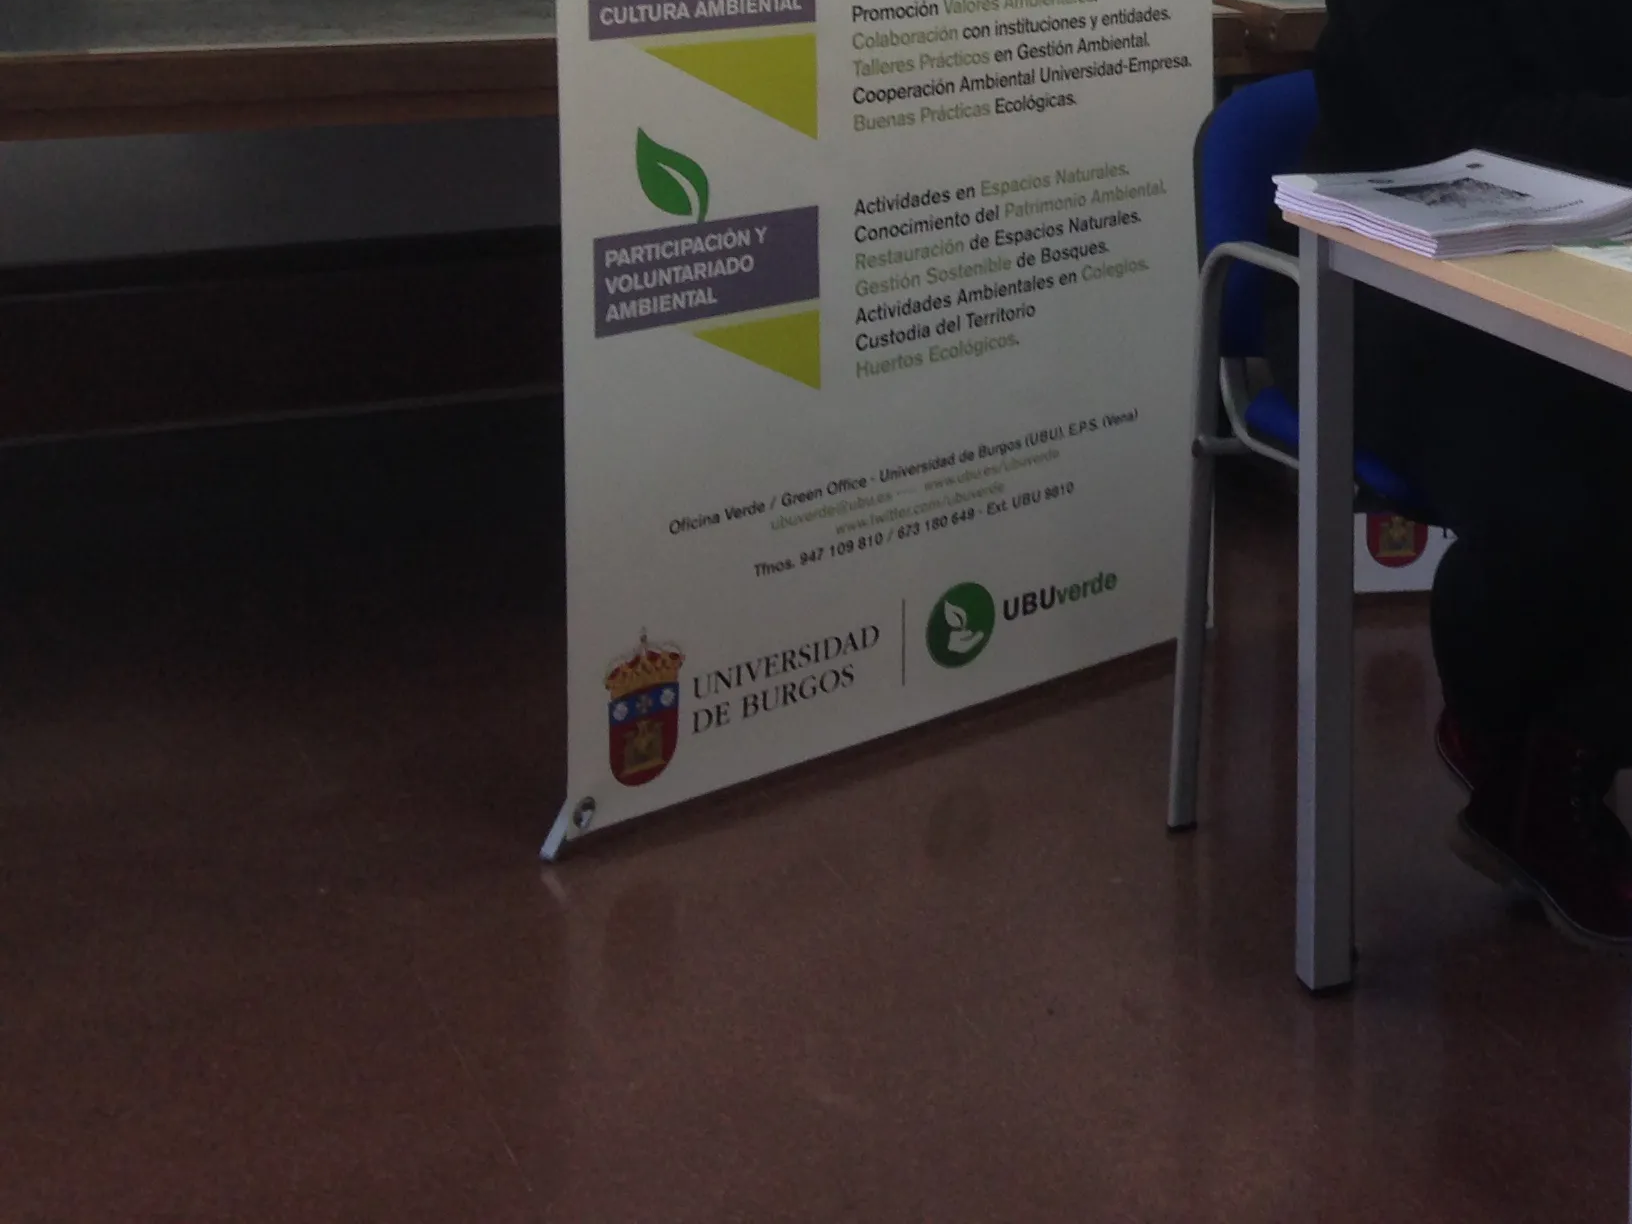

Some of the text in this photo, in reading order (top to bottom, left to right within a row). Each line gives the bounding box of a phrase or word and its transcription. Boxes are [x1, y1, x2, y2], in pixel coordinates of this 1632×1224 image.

[600, 1, 689, 25] CULTURA
[852, 1, 939, 22] Promoción
[852, 5, 1171, 50] Colaboración con instituciones y entidades.
[853, 56, 914, 77] Talleres
[919, 50, 989, 71] Prácticos
[994, 48, 1012, 63] en
[1017, 39, 1073, 60] Gestión
[853, 80, 954, 104] Cooperación
[959, 70, 1035, 92] Ambiental
[854, 109, 915, 132] Buenas
[920, 102, 991, 124] Prácticas
[854, 190, 950, 215] Actividades
[956, 185, 975, 200] en
[981, 174, 1051, 197] Espacios
[854, 213, 970, 243] Conocimiento
[976, 206, 999, 225] del
[1004, 195, 1086, 218] Patrimonio
[855, 209, 1141, 270] Restauración de Espacios Naturales.
[605, 226, 767, 268] PARTICIPACIÓN Y
[605, 254, 754, 295] VOLUNTARIADO
[856, 272, 921, 297] Gestión
[926, 257, 1011, 284] Sostenible
[1016, 251, 1036, 268] de
[606, 286, 717, 322] AMBIENTAL
[856, 295, 951, 325] Actividades
[957, 274, 1054, 305] Ambientales
[1059, 272, 1077, 285] en
[856, 302, 1036, 352] Custodia del Territorio
[857, 354, 923, 378] Huertos
[1002, 572, 1117, 621] UBUverde
[692, 624, 881, 699] UNIVERSIDAD
[692, 664, 856, 734] DE BURGOS
